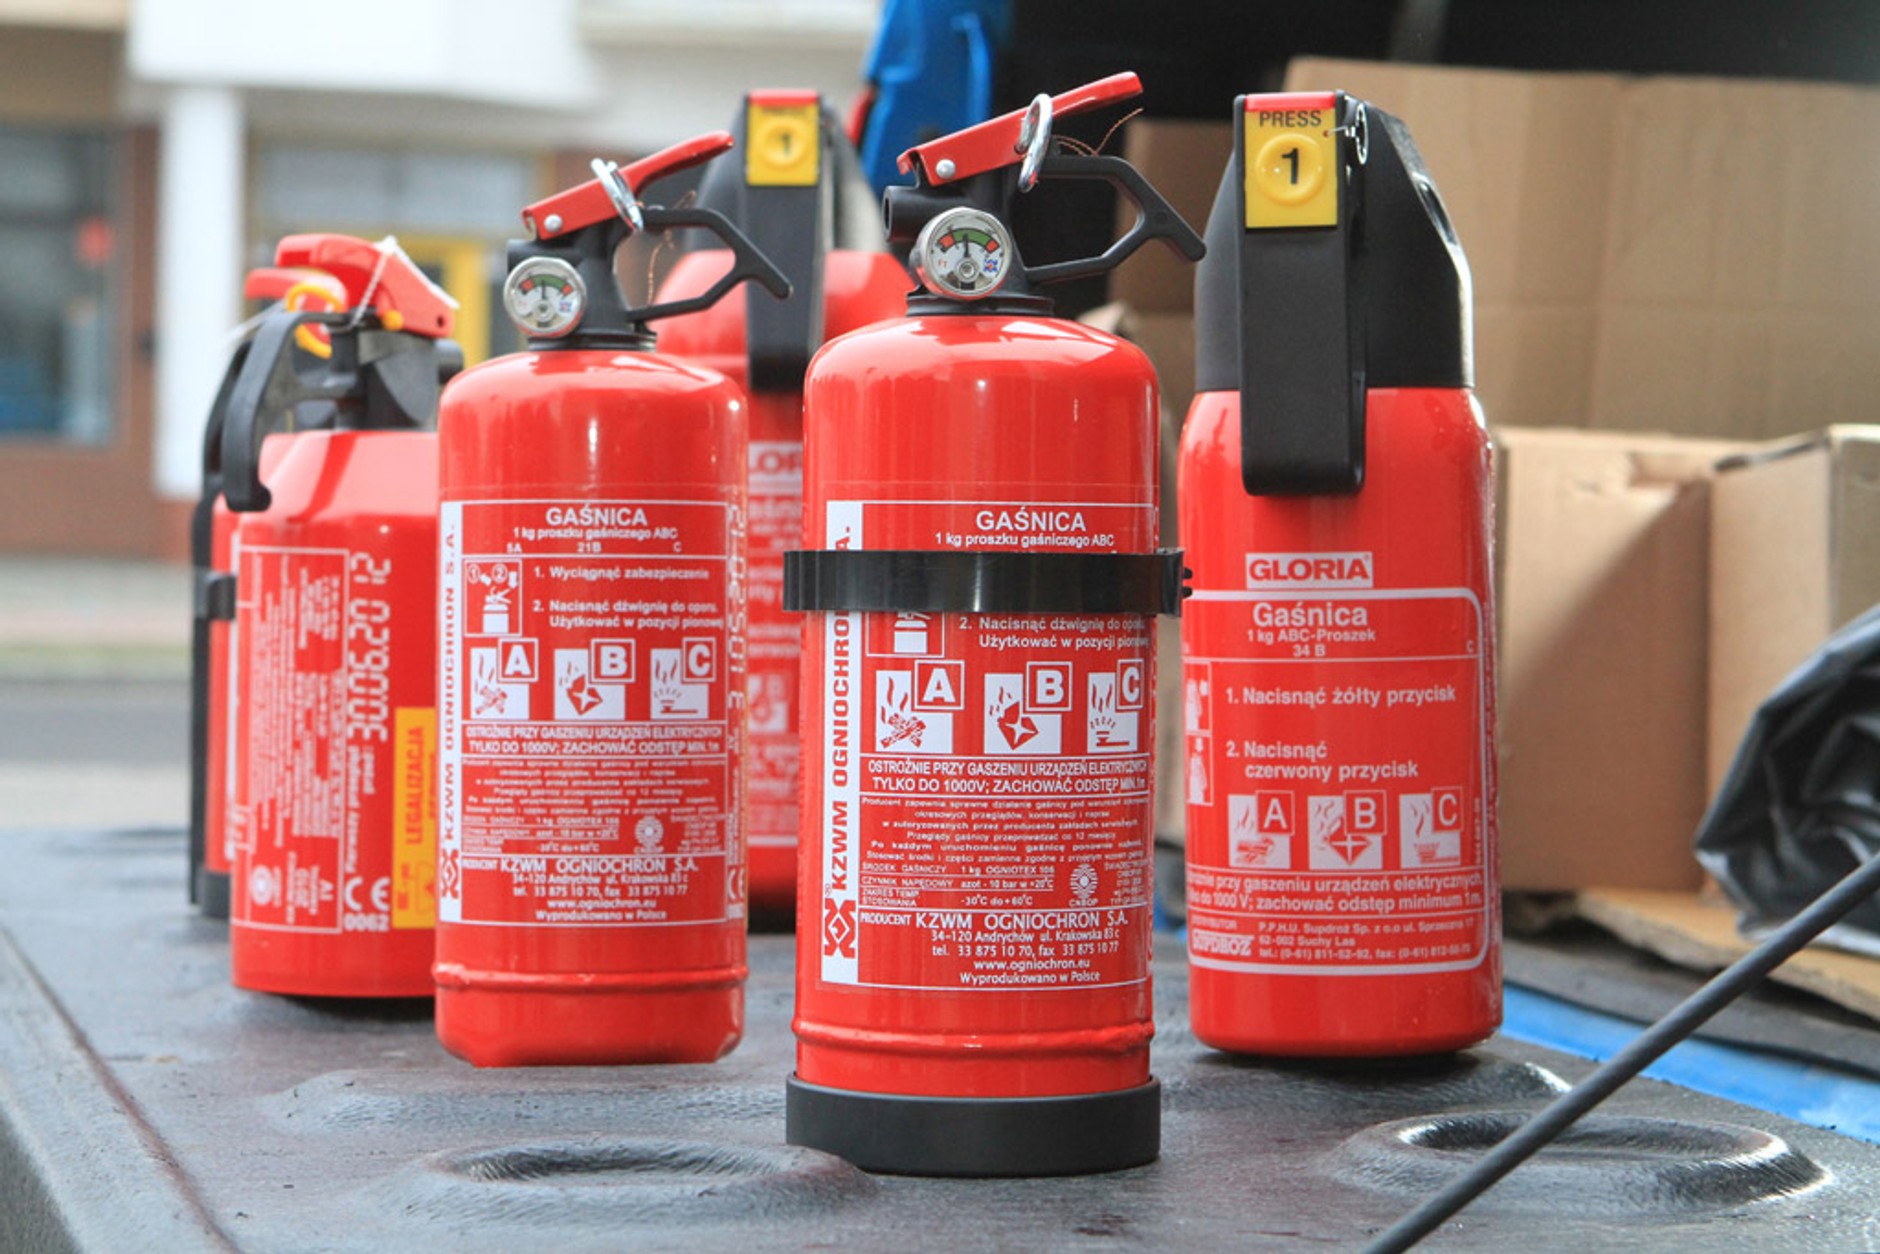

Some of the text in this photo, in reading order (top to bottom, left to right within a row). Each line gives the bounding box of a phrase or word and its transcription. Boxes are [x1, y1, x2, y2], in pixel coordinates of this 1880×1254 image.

[1259, 110, 1322, 127] PRESS
[1281, 148, 1298, 185] 1
[546, 503, 647, 526] GAŚNICA
[976, 506, 1087, 531] GAŚNICA
[513, 527, 678, 542] 1 kg proszku gaśniczego ABC
[935, 532, 1114, 549] 1 kg proszku gaśniczego ABC
[533, 567, 545, 578] 1.
[549, 566, 620, 583] Wyciągnąć
[1249, 558, 1369, 581] GLORIA
[533, 600, 685, 615] 2. Nacisnąć dźwignię do
[1253, 602, 1368, 627] Gaśnica
[549, 614, 680, 630] Użytkować w pozycji
[959, 616, 1120, 633] 2. Nacisnąć dźwignię do
[979, 634, 1115, 651] Użytkować w pozycji
[1247, 628, 1376, 645] 1 kg ABC-Proszek
[504, 644, 531, 676] A
[600, 645, 628, 676] B
[688, 644, 711, 676] C
[1293, 644, 1326, 656] 34 B
[444, 587, 455, 750] OGNIOCHRON
[922, 668, 956, 703] A
[1036, 670, 1064, 703] B
[1122, 669, 1140, 701] C
[1226, 685, 1455, 709] 1. Nacisnąć żółty przycisk
[562, 740, 637, 754] ZACHOWAĆ
[831, 611, 849, 891] KZWM OGNIOCHRO
[1226, 741, 1327, 762] 2. Nacisnąć
[868, 757, 1087, 778] OSTROŻNIE PRZY GASZENIU URZĄDZEŃ
[1245, 760, 1418, 783] czerwony przycisk
[406, 726, 423, 845] LEGALIZACJA
[872, 777, 1119, 794] TYLKO DO 1000V; ZACHOWAĆ ODSTĘP
[444, 763, 455, 840] KZWM
[1438, 794, 1457, 826] C
[1263, 798, 1288, 829] A
[1354, 797, 1377, 829] B
[556, 856, 667, 874] OGNIOCHRON
[673, 857, 699, 872] S.A.
[1244, 877, 1310, 893] gaszeniu
[1315, 877, 1390, 895] urządzeń
[1256, 896, 1334, 911] zachować
[1338, 896, 1395, 915] odstęp
[1398, 894, 1462, 910] minimum
[860, 910, 1128, 930] PRODUCENT KZWM OGNIOCHRON S.A.
[931, 928, 1120, 944] 34-120 Andrychów ul. Krakowska 83 c
[932, 941, 1119, 960] tel. 33 875 10 70, fax 33 875 10 77
[973, 959, 1090, 972] www.ogniochron.eu
[960, 972, 1057, 986] Wyprodukowano
[1070, 971, 1100, 982] Polsce
